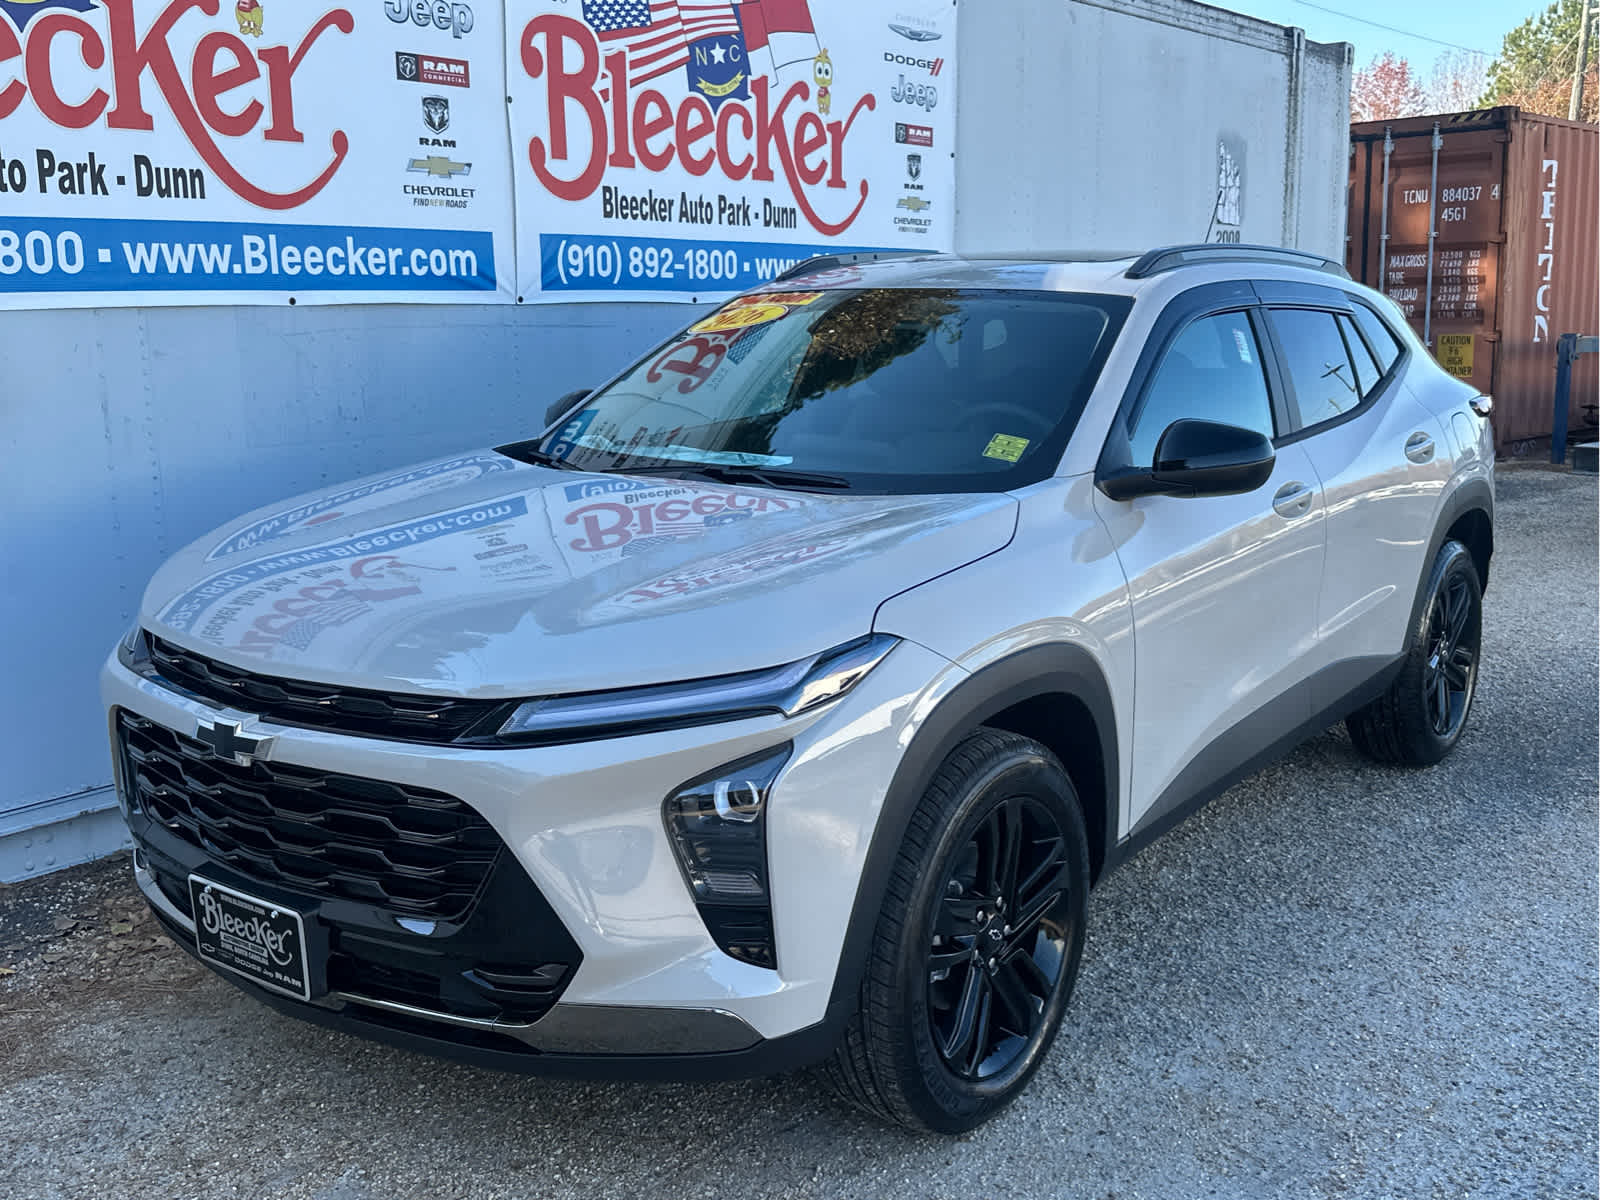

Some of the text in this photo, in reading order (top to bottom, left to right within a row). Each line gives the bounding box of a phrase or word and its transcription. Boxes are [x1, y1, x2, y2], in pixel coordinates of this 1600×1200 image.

[384, 0, 474, 39] Jeep
[423, 60, 465, 75] RAM
[884, 51, 936, 70] DODGE
[423, 73, 466, 84] COMMERCIAL
[891, 74, 938, 112] Jeep
[520, 14, 876, 236] Bleecker
[908, 128, 931, 137] RAM
[419, 137, 457, 148] RAM
[36, 148, 109, 196] Park
[134, 153, 206, 200] Dunn
[403, 184, 475, 199] CHEVROLET
[904, 183, 924, 191] RAM
[1403, 183, 1500, 205] TCNU 884037 4
[602, 185, 797, 230] Bleecker Auto Park Dunn
[1441, 206, 1467, 222] 45G1
[122, 234, 478, 278] www.Bleecker.com
[557, 239, 622, 285] (910)
[629, 246, 738, 280] 892-1800
[1441, 335, 1471, 345] CAUTION
[199, 892, 293, 966] Bleecker
